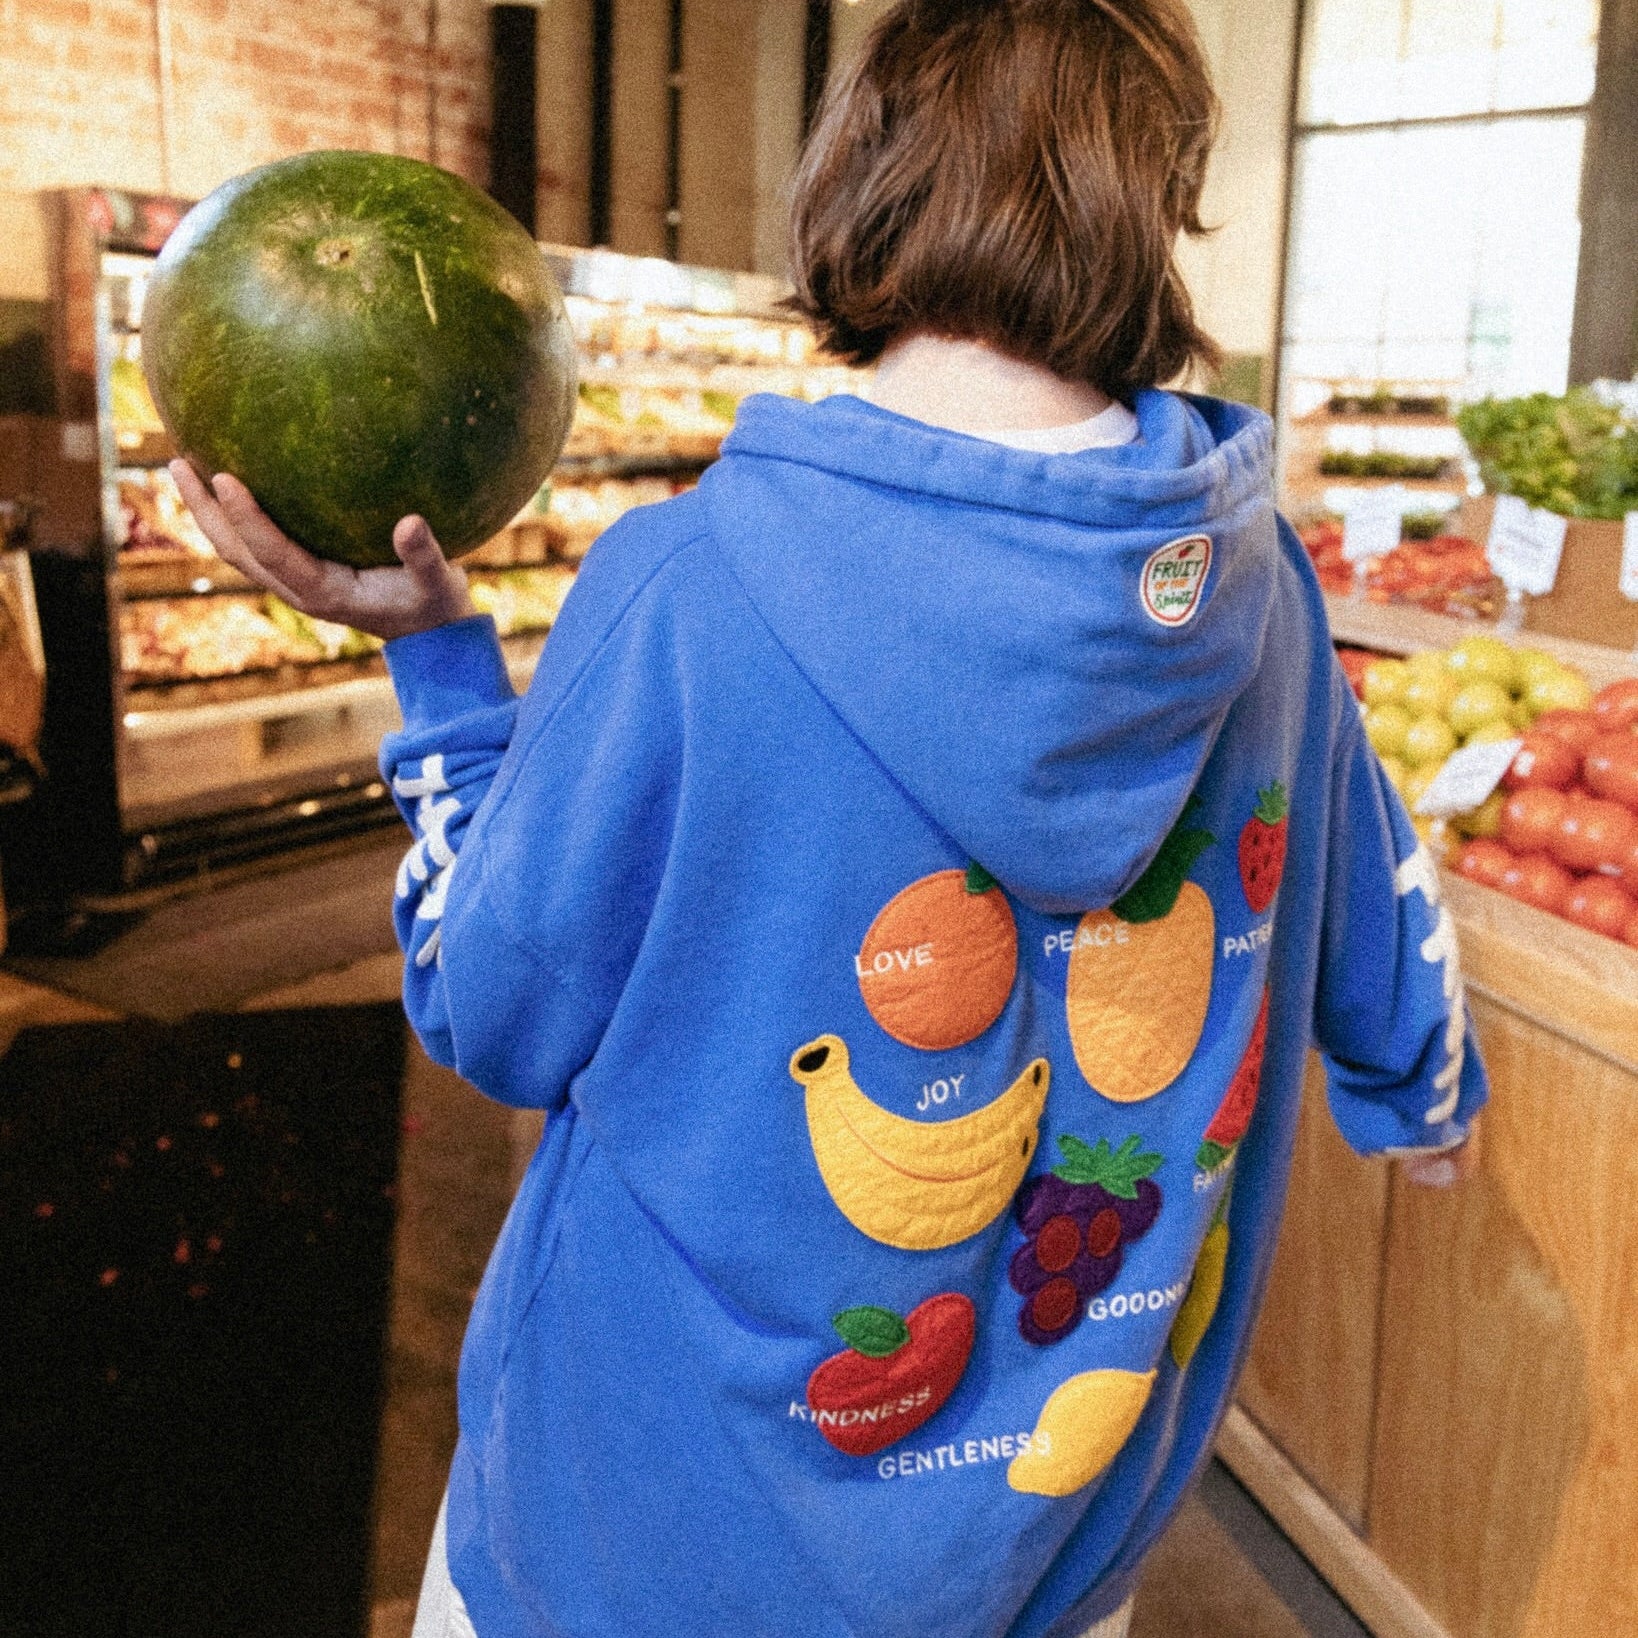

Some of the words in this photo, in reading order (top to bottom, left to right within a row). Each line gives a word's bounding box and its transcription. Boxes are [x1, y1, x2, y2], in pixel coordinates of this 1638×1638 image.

[1152, 560, 1202, 579] FRUIT
[1044, 921, 1130, 956] PEACE
[854, 942, 935, 978] LOVE
[915, 1073, 966, 1112] JOY
[787, 1386, 933, 1427] KINDNESS
[877, 1430, 1051, 1480] GENTLENESS
